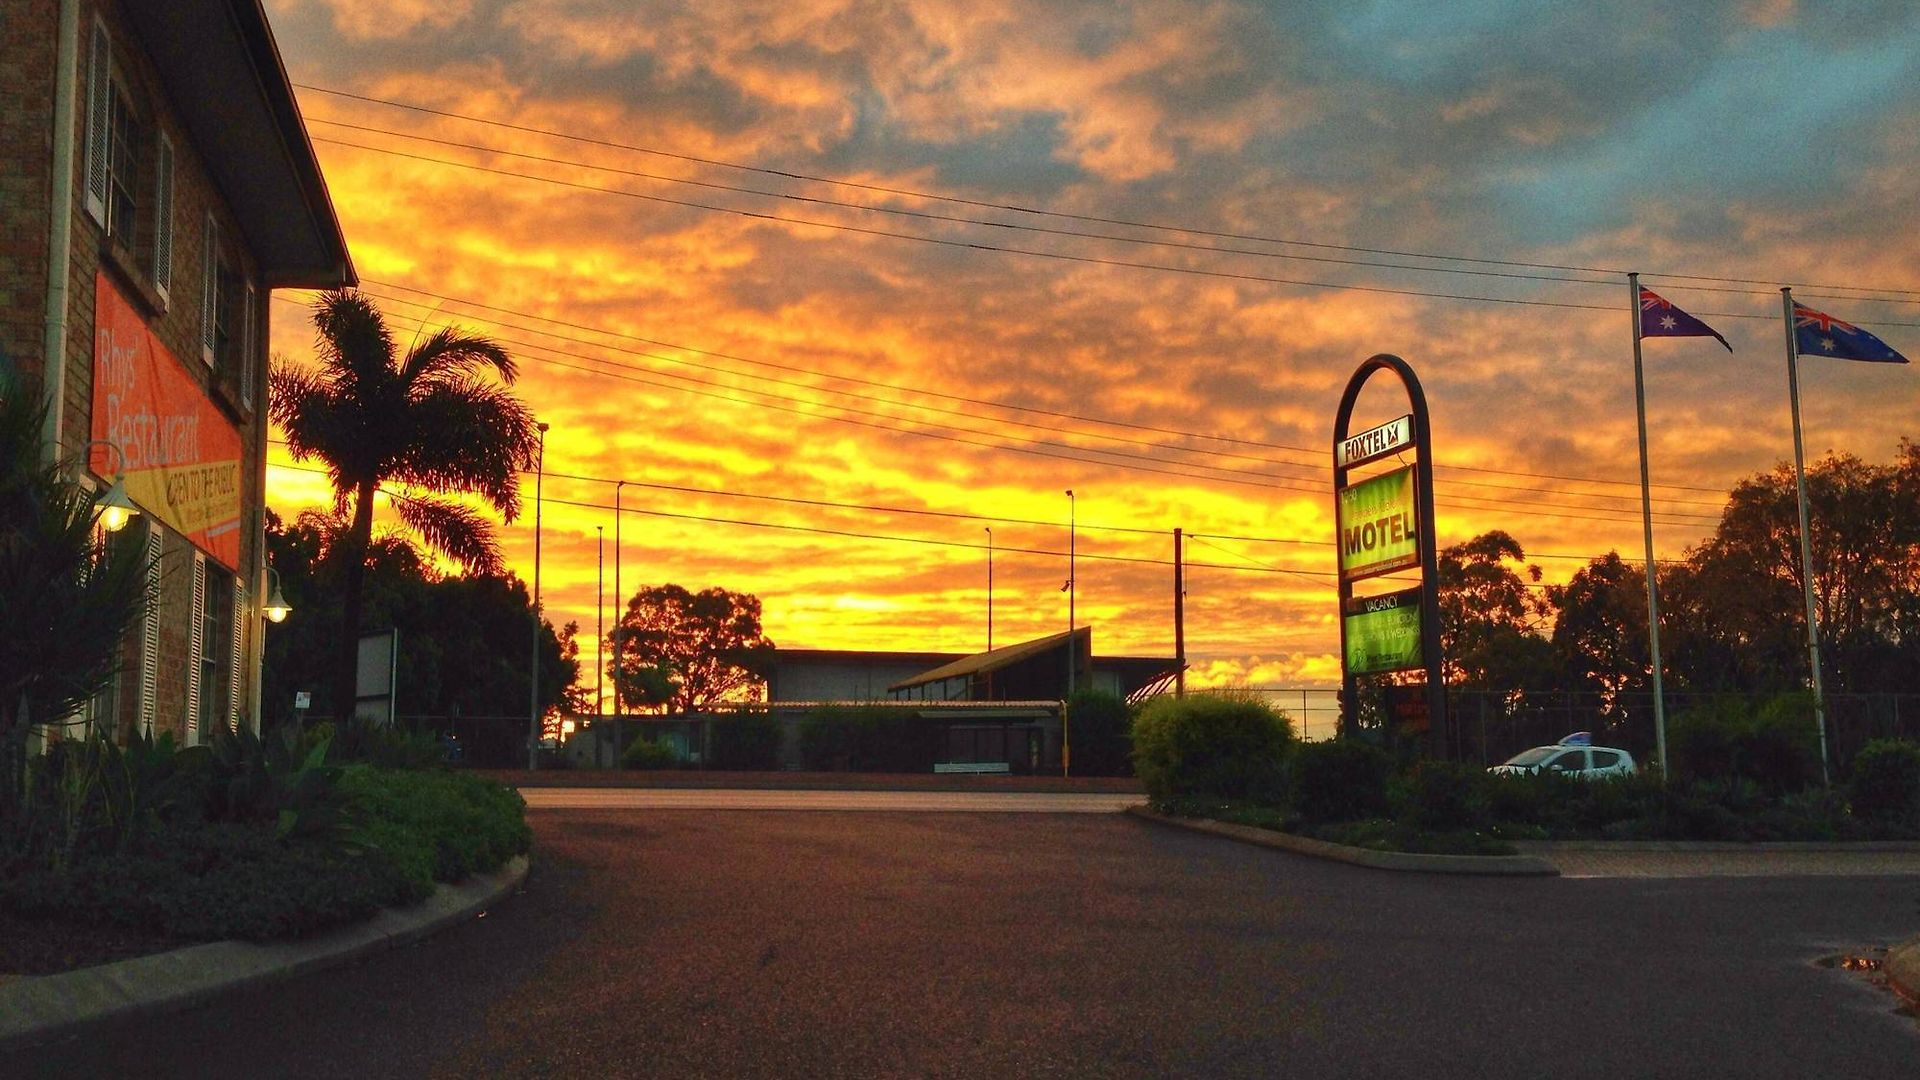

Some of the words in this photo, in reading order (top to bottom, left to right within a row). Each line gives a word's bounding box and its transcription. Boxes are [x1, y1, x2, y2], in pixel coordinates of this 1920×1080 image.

[107, 394, 199, 471] Restaurant
[1345, 428, 1386, 463] FOXTEL
[167, 472, 189, 507] OPEN
[189, 470, 201, 501] TO
[201, 467, 214, 498] THE
[214, 463, 236, 496] PUBLIC
[1344, 511, 1415, 557] MOTEL
[1365, 595, 1398, 612] VACANCY
